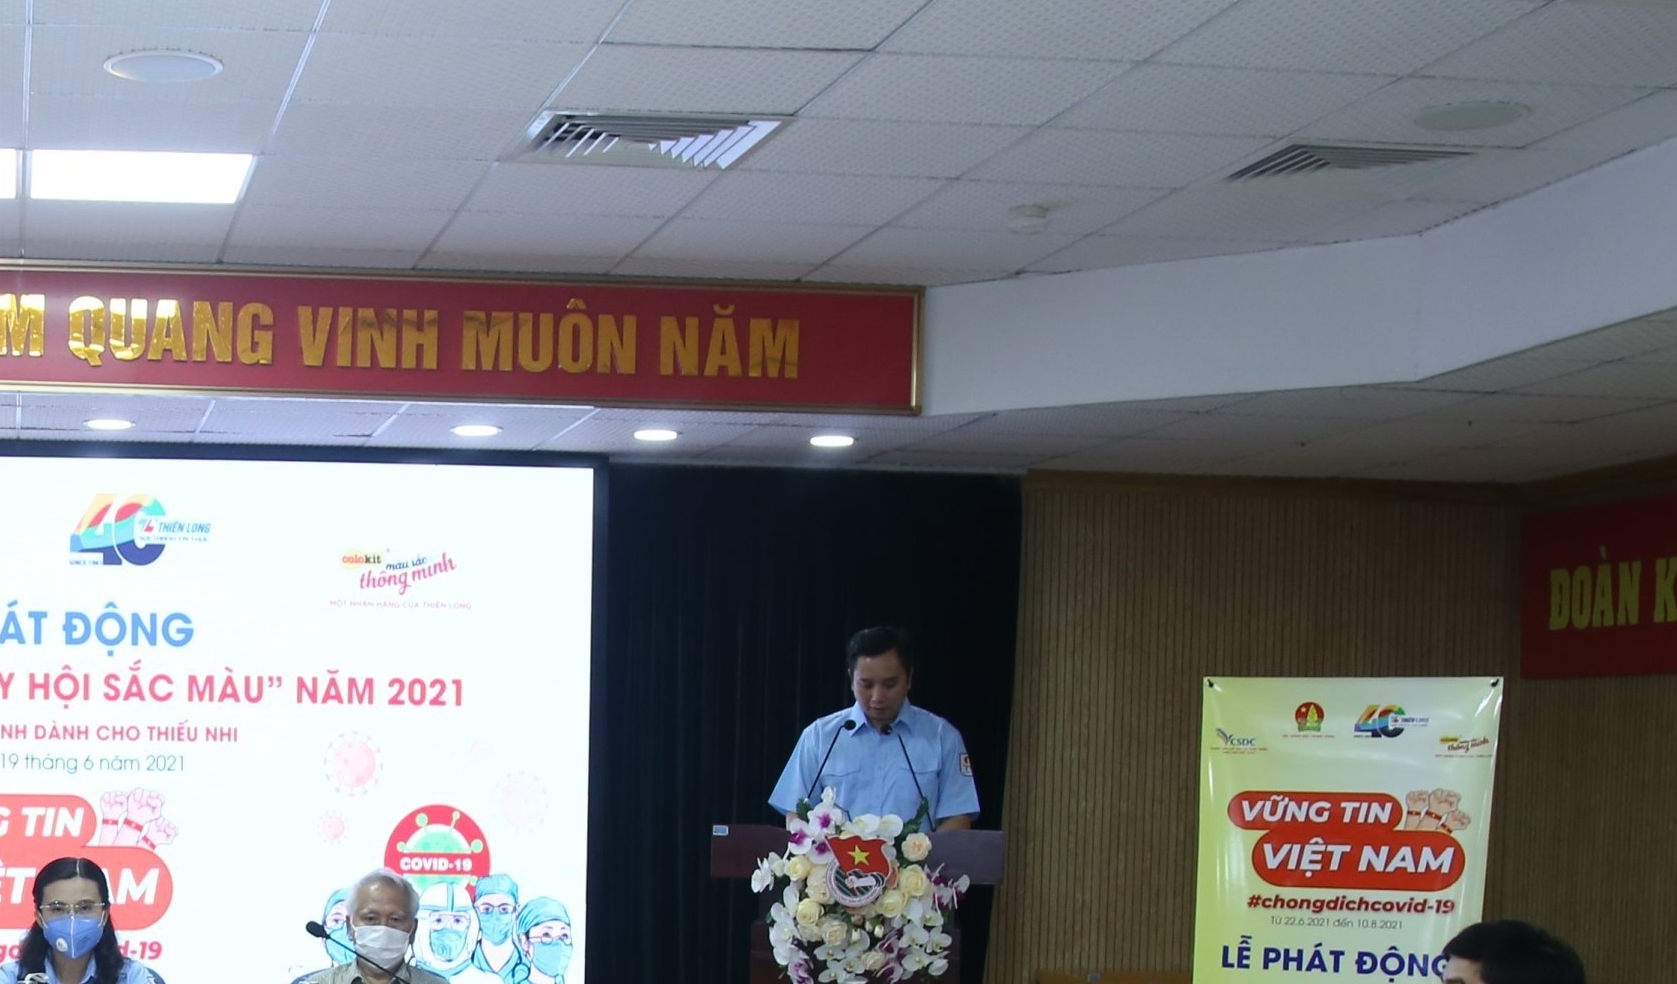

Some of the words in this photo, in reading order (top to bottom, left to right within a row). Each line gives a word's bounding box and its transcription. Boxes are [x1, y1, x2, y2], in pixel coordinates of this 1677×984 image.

[69, 296, 274, 366] QUANG
[298, 305, 439, 370] VINH
[462, 298, 637, 375] MUÔN
[660, 304, 800, 379] NĂM
[342, 553, 381, 564] colokit
[1549, 545, 1642, 630] ĐOÀN
[62, 601, 194, 657] ĐỘNG
[29, 665, 89, 709] HỘI
[104, 659, 173, 702] SẮC
[297, 669, 374, 704] NĂM
[388, 678, 462, 706] 2021
[35, 721, 88, 740] DÀNH
[96, 725, 140, 741] CHO
[147, 720, 197, 742] THIẾU
[206, 727, 237, 742] NHI
[1, 753, 19, 768] 19
[25, 754, 77, 774] tháng
[84, 755, 94, 770] 6
[100, 756, 140, 771] năm
[146, 755, 183, 771] 2021
[22, 806, 84, 838] TIN
[1241, 795, 1331, 823] VỮNG
[1340, 801, 1392, 824] TIN
[400, 857, 472, 871] COVID-19
[1262, 837, 1351, 878] VIỆT
[1358, 845, 1455, 874] NAM
[1247, 895, 1455, 914] #chongdichcovid-19
[1221, 935, 1252, 969] LỄ
[1263, 942, 1345, 973] PHÁT
